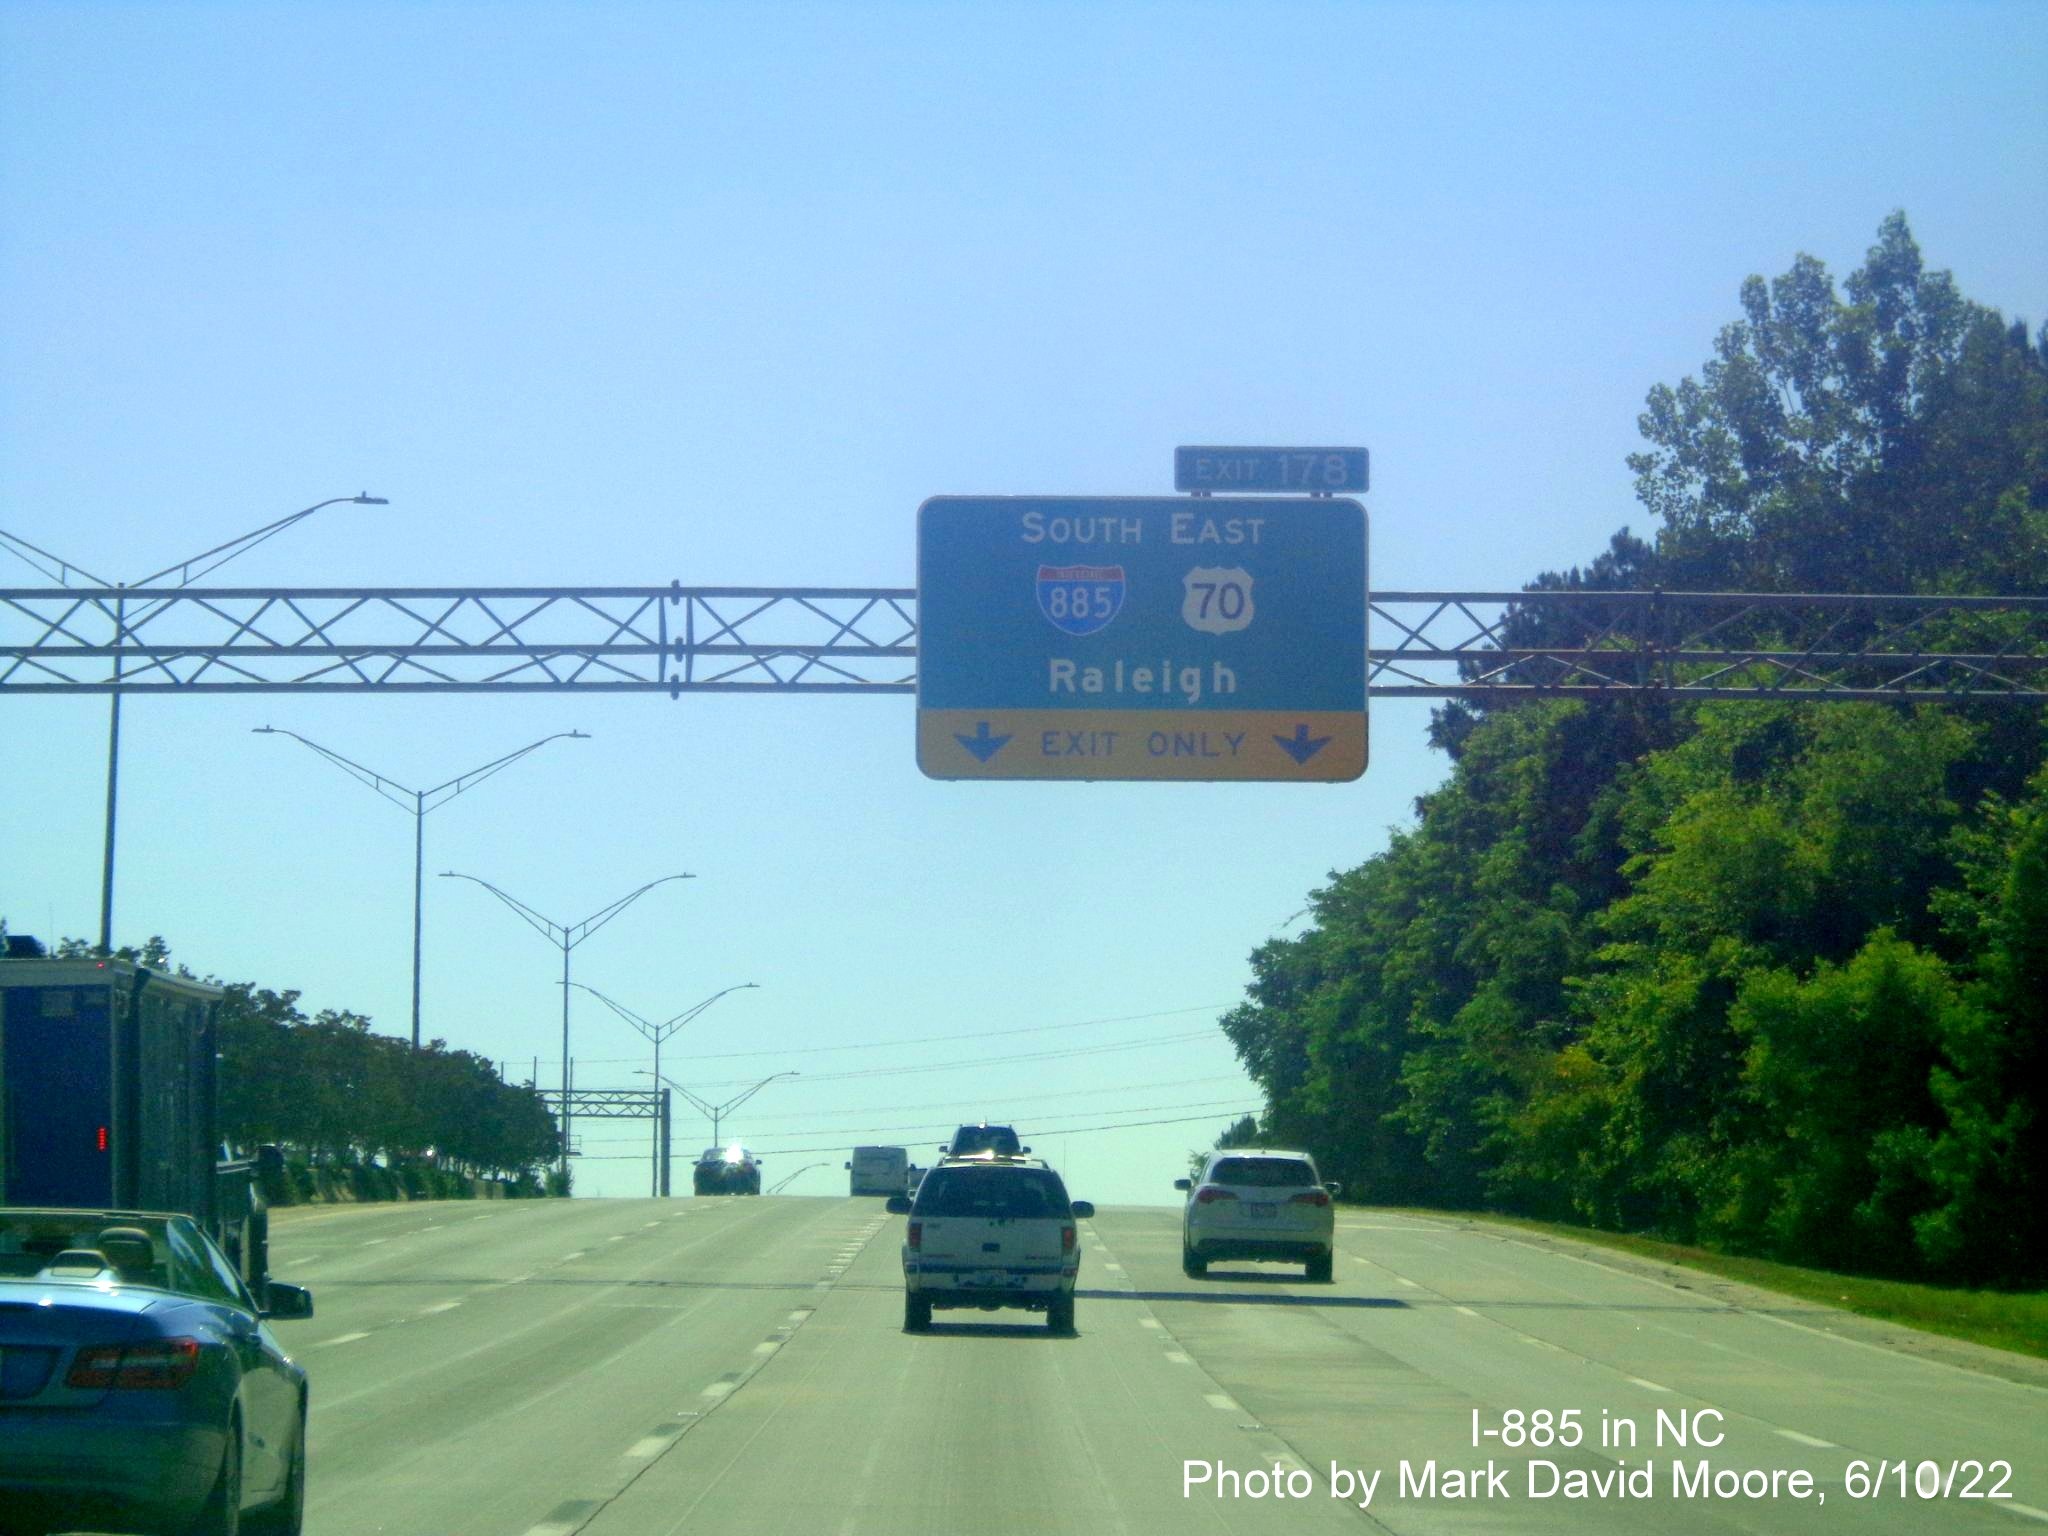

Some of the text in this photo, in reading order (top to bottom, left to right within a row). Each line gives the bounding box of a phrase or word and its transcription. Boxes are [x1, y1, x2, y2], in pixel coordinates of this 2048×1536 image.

[1196, 454, 1347, 485] EXIT 178
[1022, 512, 1265, 546] SOUTH EAST
[1050, 587, 1111, 618] 885
[1191, 581, 1246, 620] 70
[1049, 659, 1237, 703] Raleigh
[1041, 731, 1247, 758] EXIT ONLY
